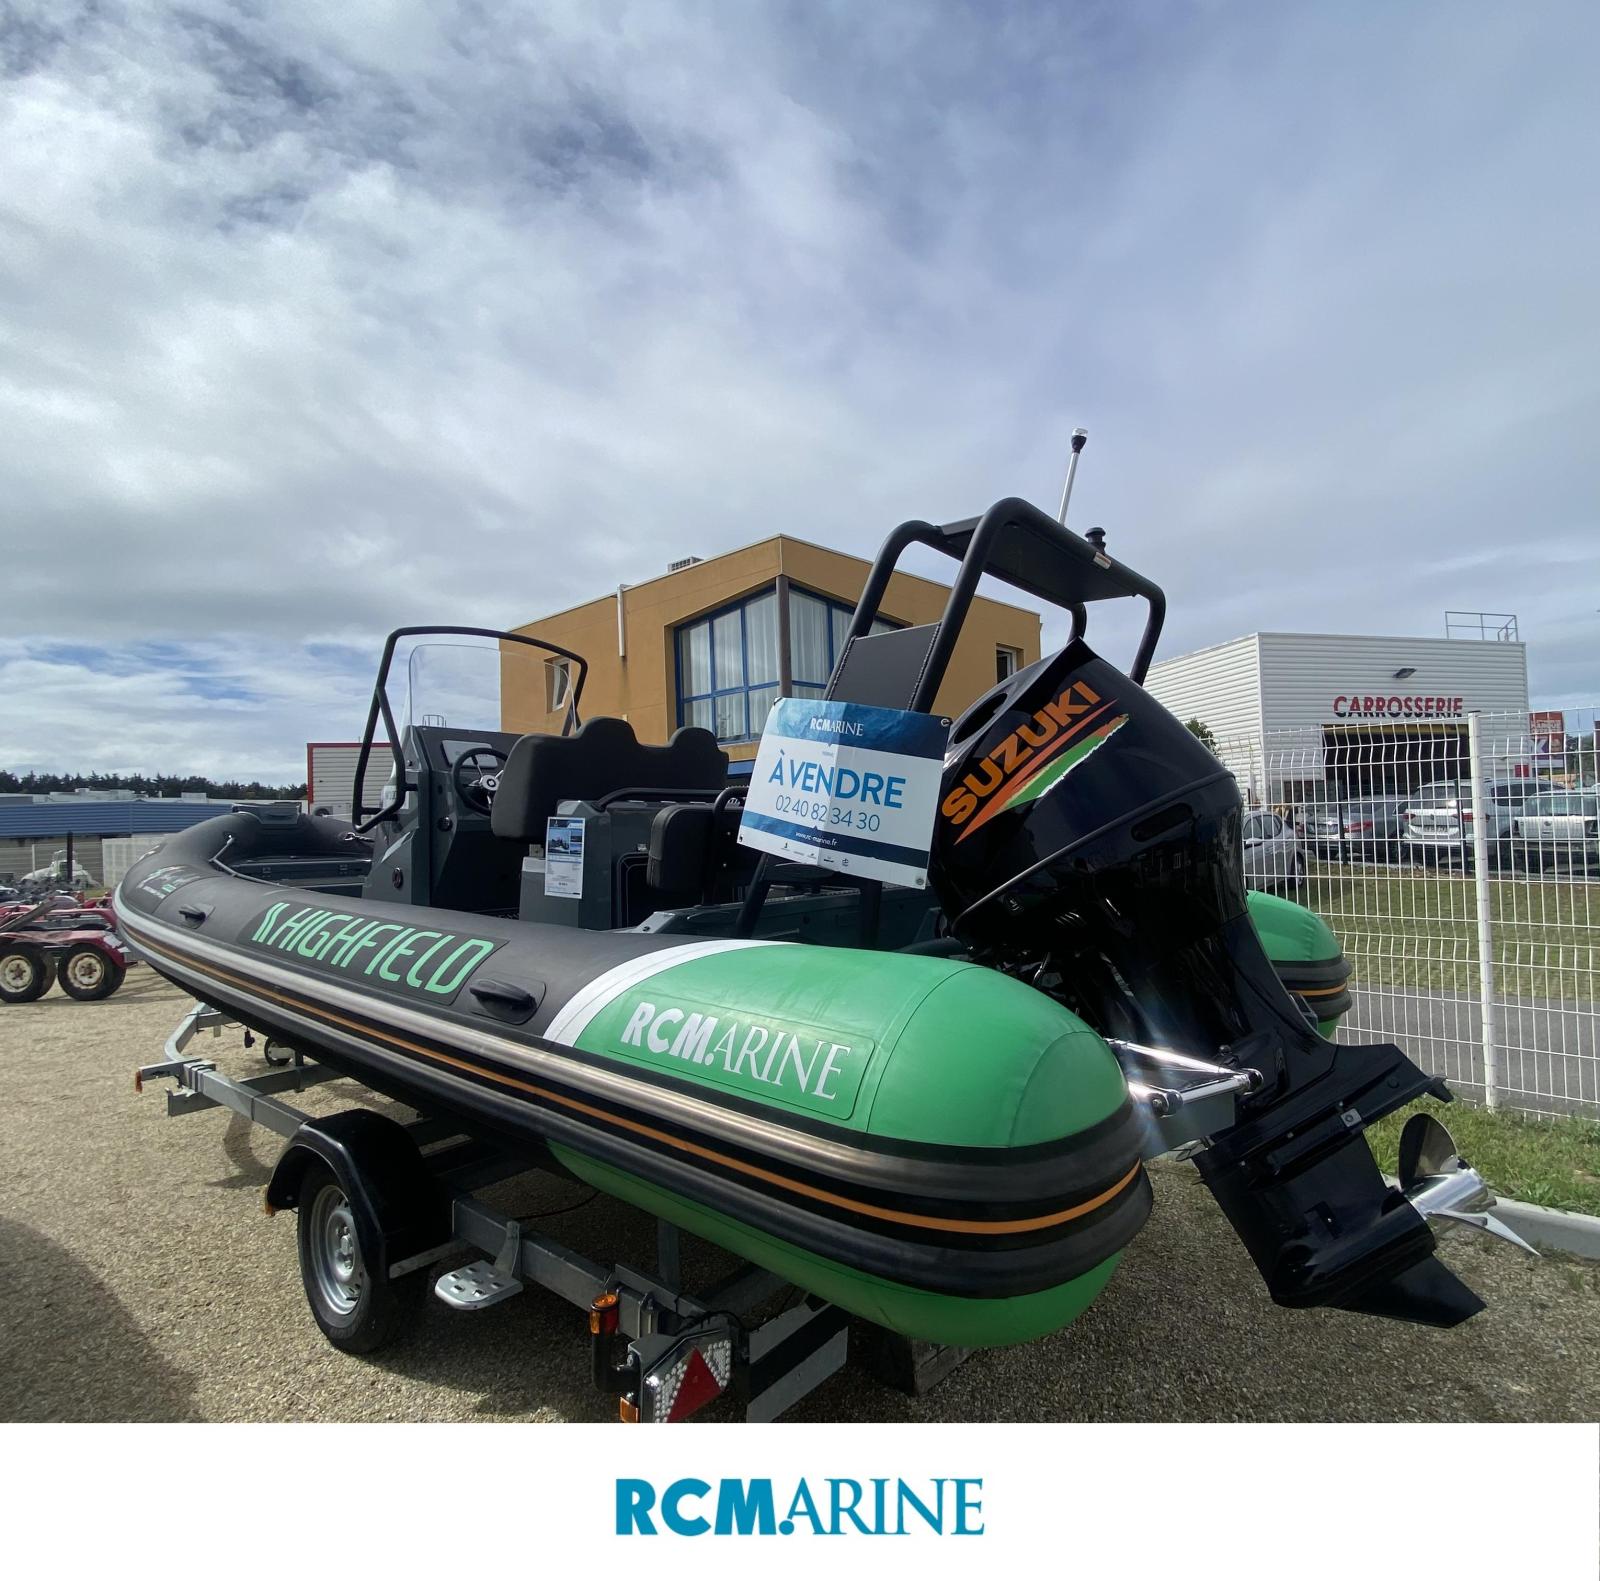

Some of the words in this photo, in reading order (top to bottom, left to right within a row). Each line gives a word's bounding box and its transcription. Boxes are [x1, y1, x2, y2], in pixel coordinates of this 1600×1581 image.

[810, 717, 865, 737] RCMARINE
[1333, 696, 1463, 718] CARROSSERIE
[942, 681, 1101, 825] SUZUKI
[768, 748, 784, 786] À
[790, 759, 906, 809] VENDRE
[775, 794, 791, 813] 02
[792, 799, 809, 817] 40
[811, 803, 828, 822] 82
[830, 807, 852, 827] 34
[856, 812, 880, 832] 30
[267, 907, 494, 994] HIGHFIELD
